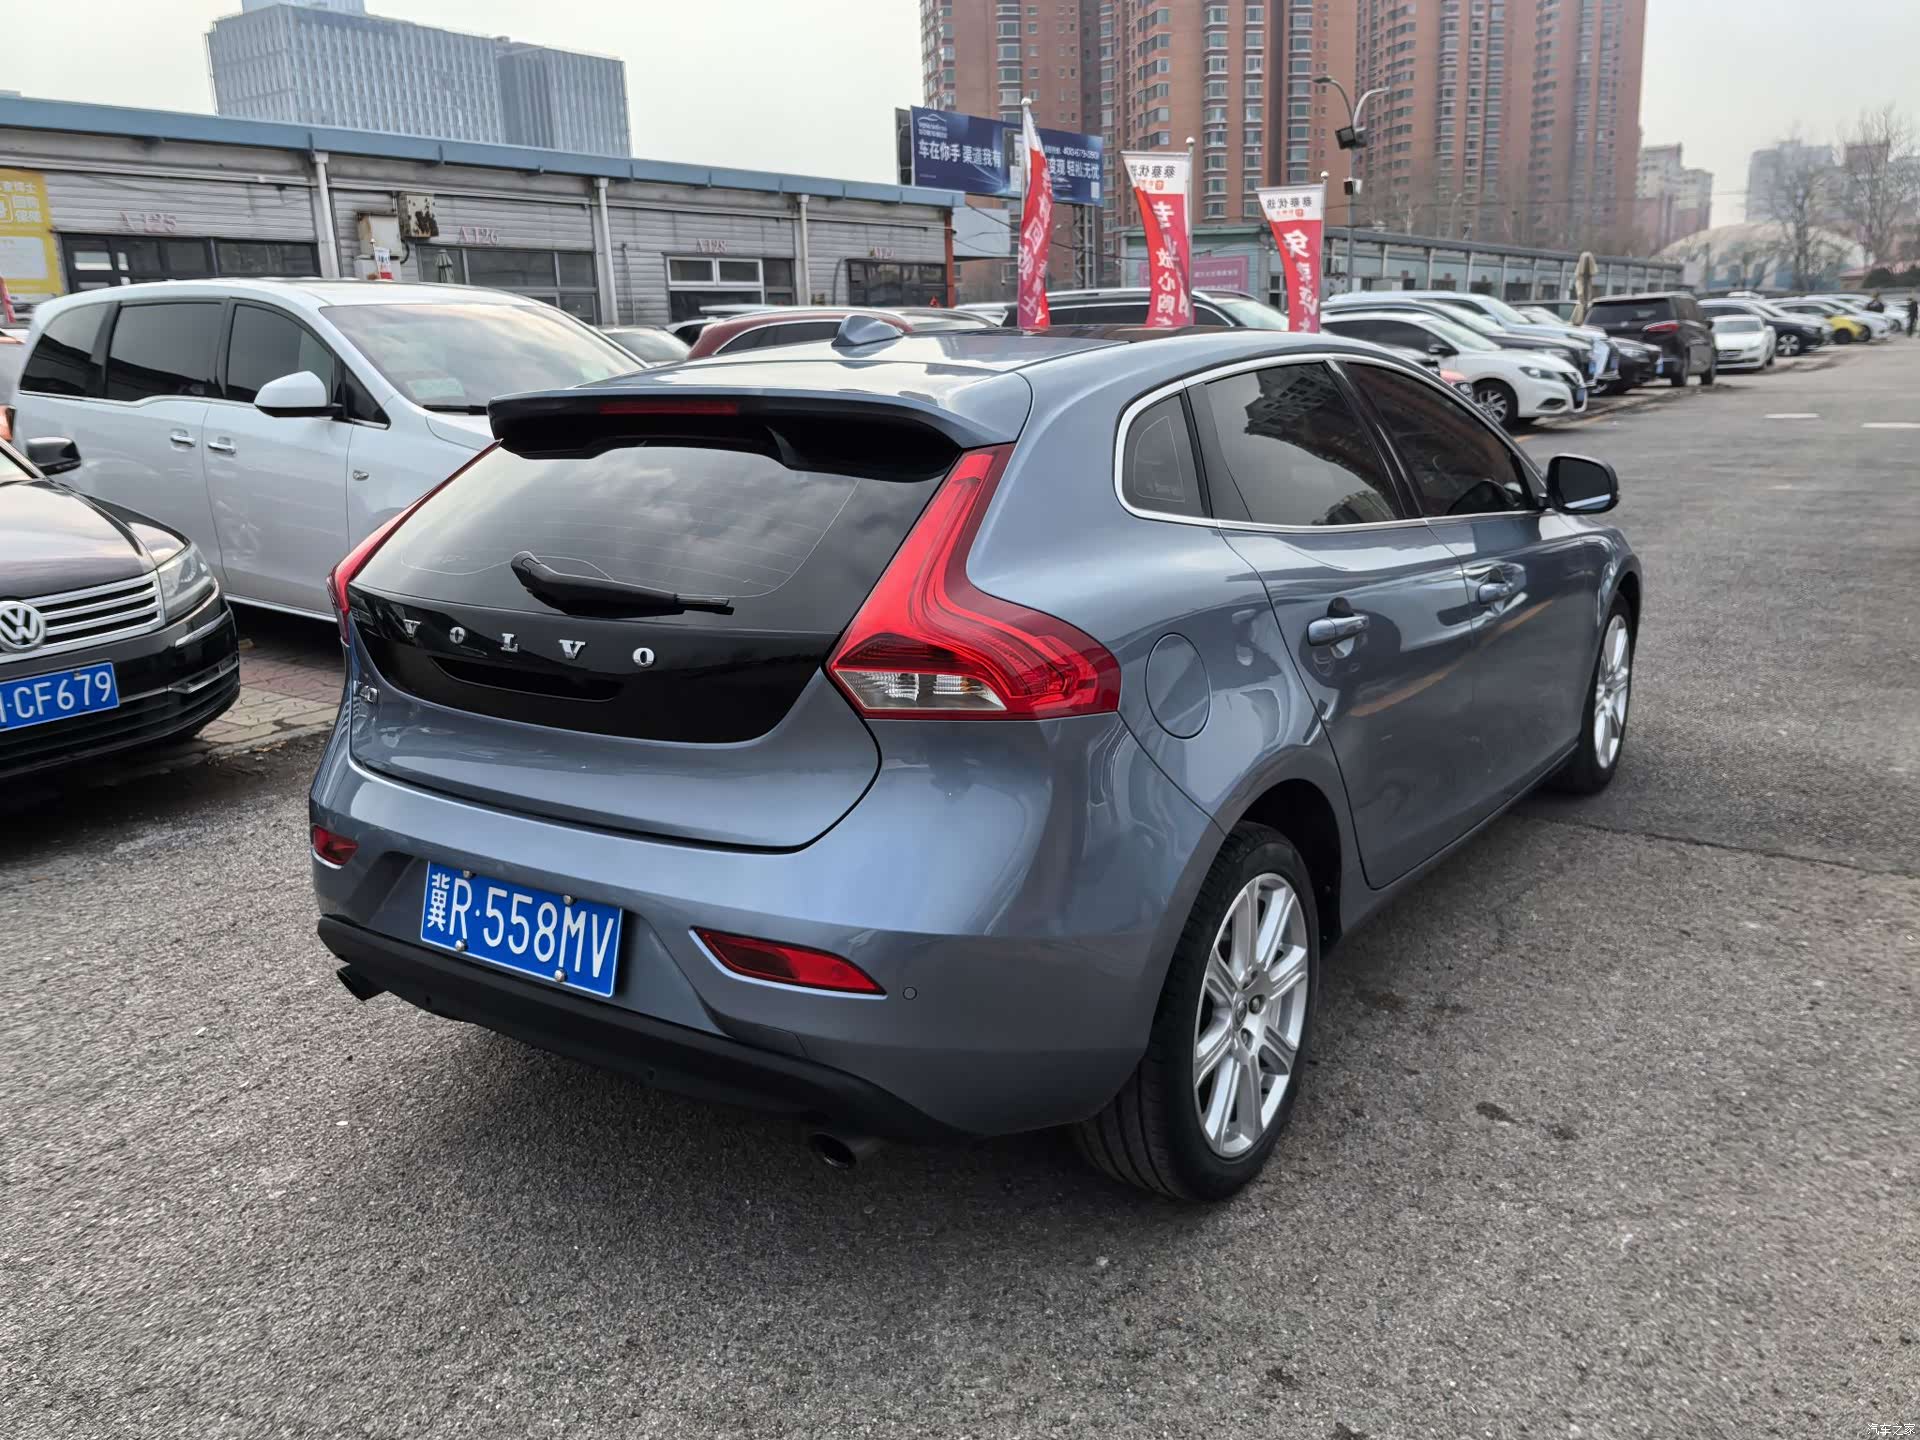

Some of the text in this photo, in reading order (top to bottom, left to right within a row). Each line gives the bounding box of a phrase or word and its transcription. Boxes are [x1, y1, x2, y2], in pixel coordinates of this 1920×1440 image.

[918, 138, 1001, 168] 车在你手 渠道我有
[1067, 160, 1100, 180] 轻松无忧
[696, 238, 728, 253] A128
[403, 618, 656, 668] VOLVO
